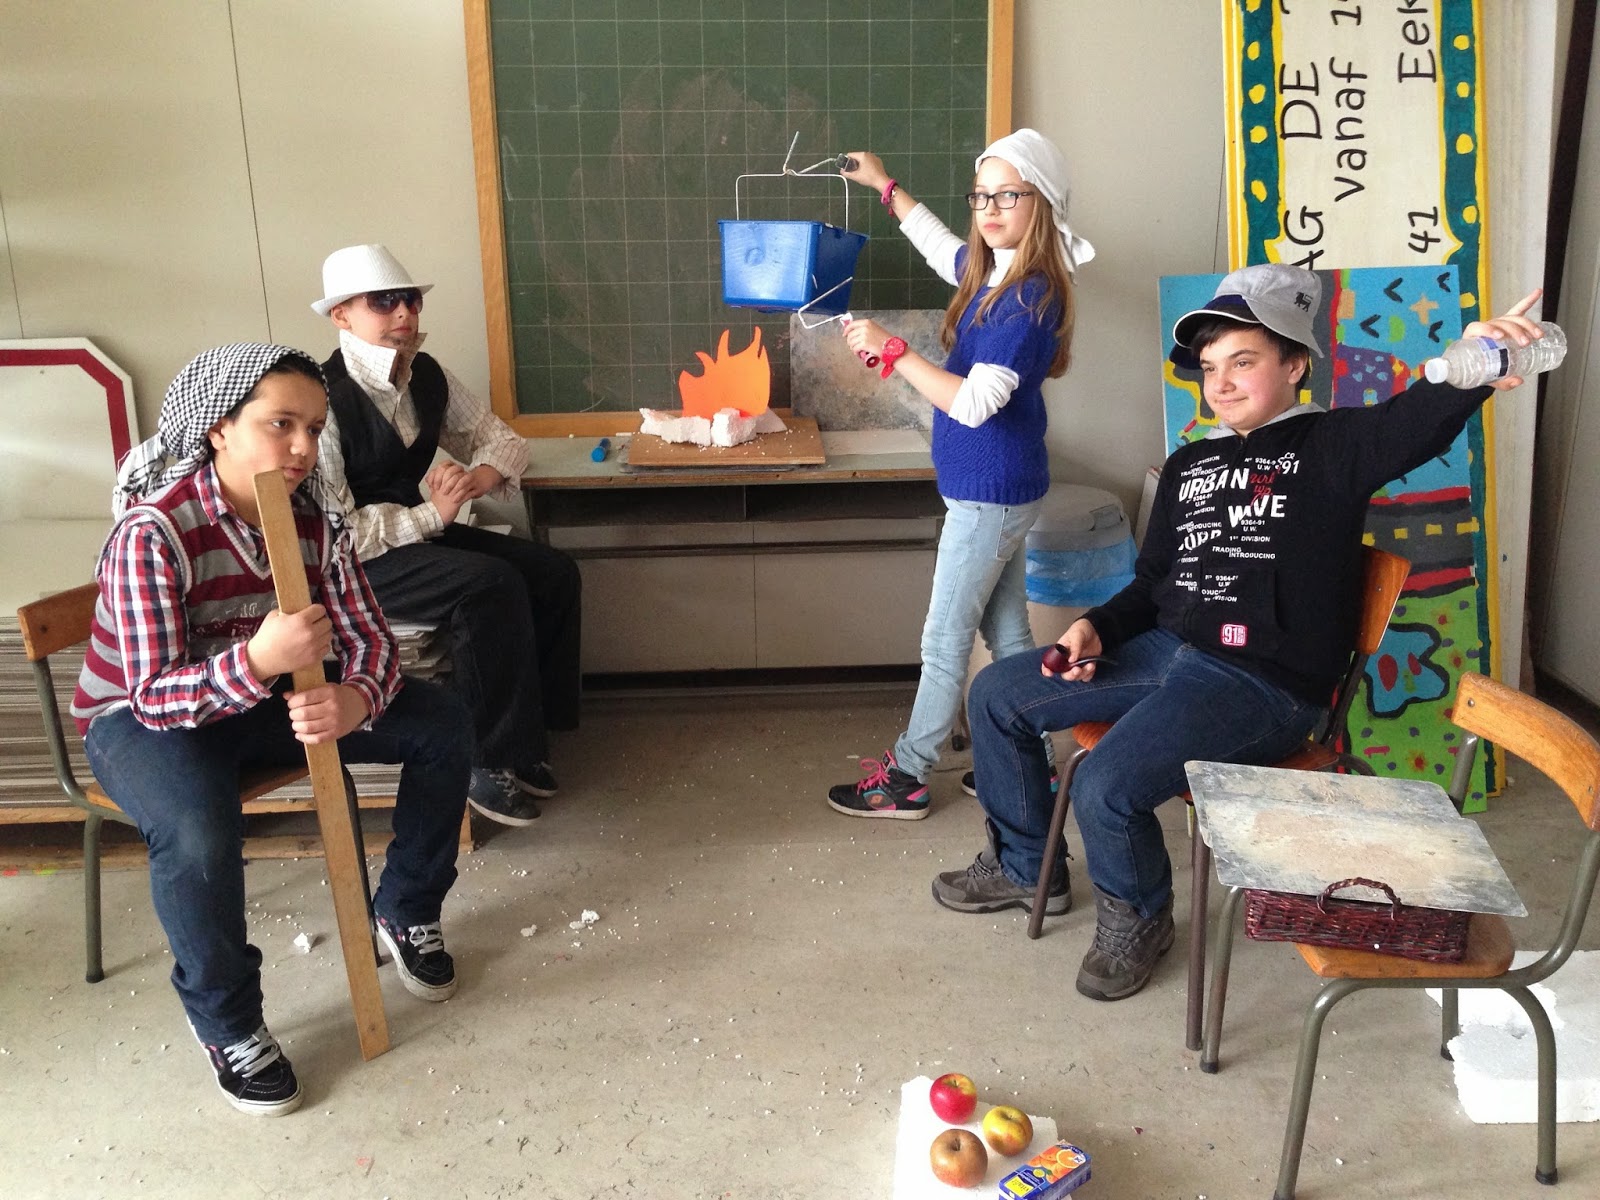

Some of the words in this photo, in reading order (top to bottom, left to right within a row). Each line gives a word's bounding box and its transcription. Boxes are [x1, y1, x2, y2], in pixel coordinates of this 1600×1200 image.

[1279, 61, 1323, 141] DE
[1328, 56, 1368, 202] vanaf
[1407, 206, 1441, 254] 41
[1282, 459, 1300, 475] 91
[1178, 468, 1250, 502] URBAN
[1212, 545, 1242, 553] TRADING
[1241, 535, 1271, 543] DIVISION
[1229, 551, 1276, 560] INTRODUCING
